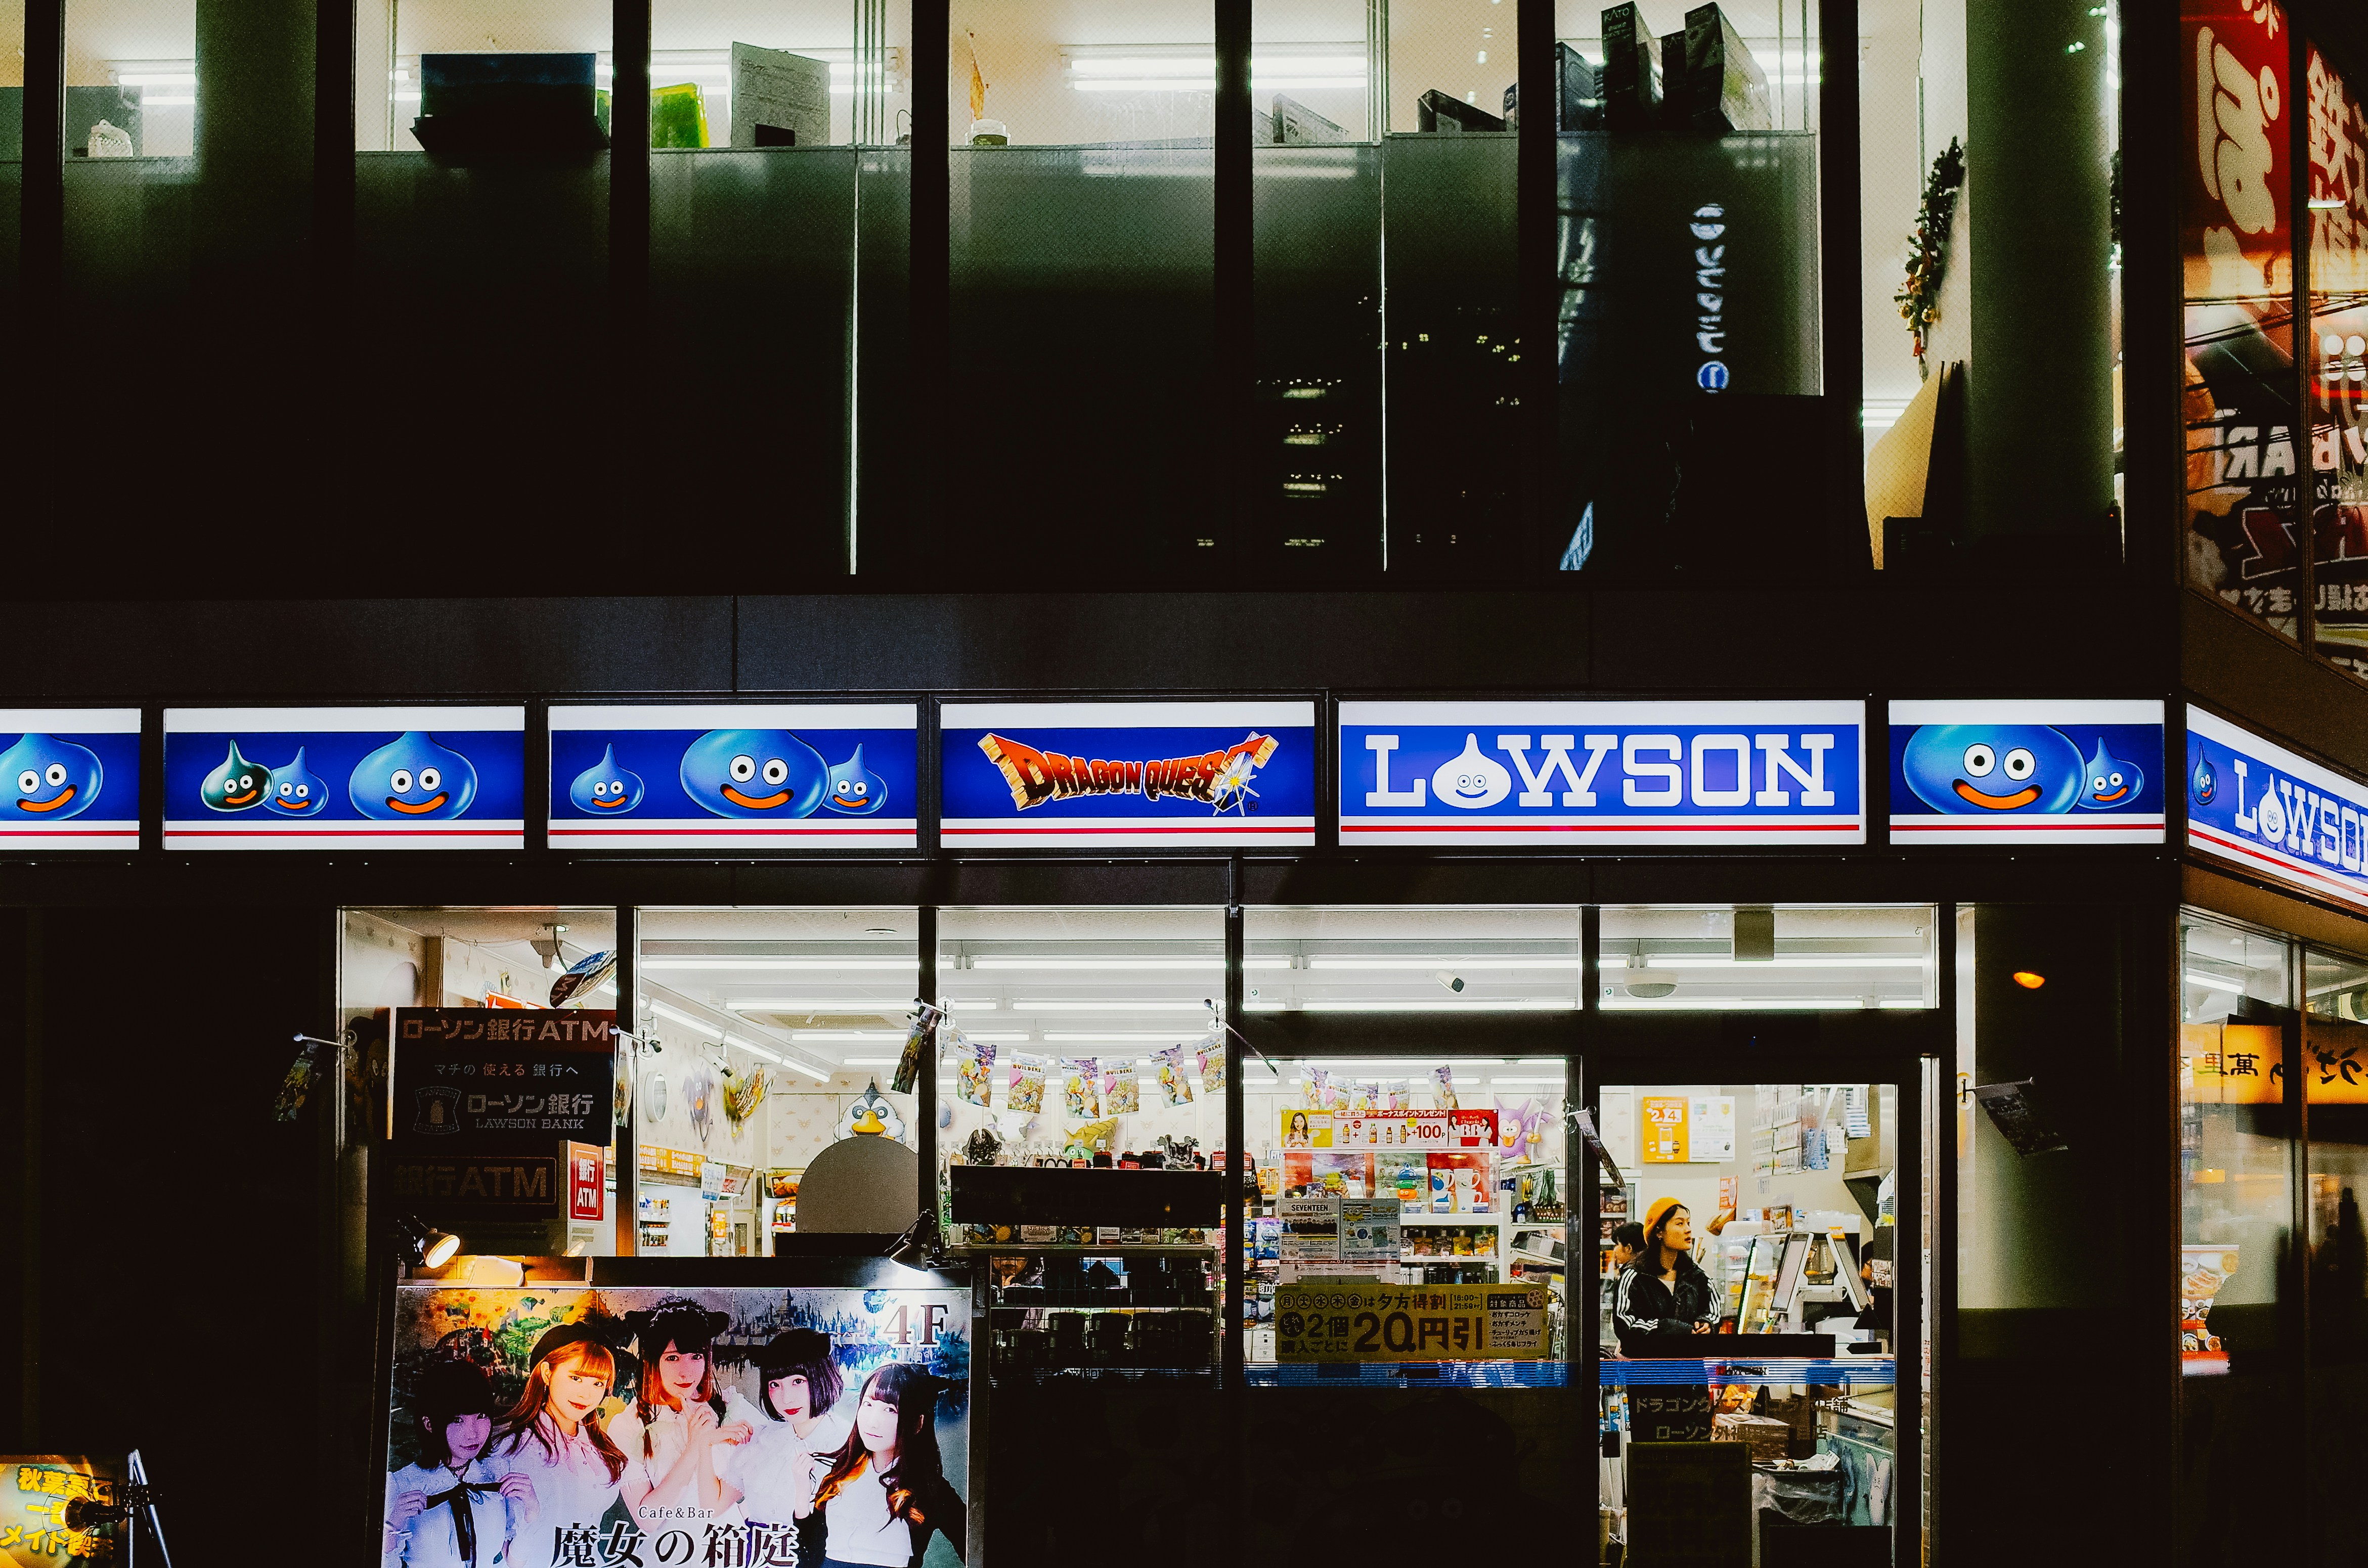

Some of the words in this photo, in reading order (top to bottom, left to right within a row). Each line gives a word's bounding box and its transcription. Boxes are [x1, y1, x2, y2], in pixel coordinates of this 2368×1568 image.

[978, 732, 1143, 811] DRAGON
[1145, 733, 1279, 810] QUEST
[403, 1017, 608, 1042] ローソン銀行ATM
[1197, 1044, 1221, 1056] BUILDERS
[434, 1063, 475, 1076] マチの
[483, 1063, 525, 1077] 使える
[533, 1063, 579, 1077] 銀行へ
[1013, 1064, 1041, 1072] BUILDERS
[467, 1093, 594, 1116] ローソン銀行
[475, 1118, 537, 1129] LAWSON
[541, 1118, 584, 1129] BANK
[578, 1159, 595, 1183] 銀行
[577, 1187, 597, 1209] ATM
[1291, 1204, 1329, 1212] SEVENTEEN
[1489, 1300, 1526, 1309] 対象商品
[883, 1305, 949, 1345] 4F
[638, 1506, 714, 1518] Cafe&Bar
[551, 1521, 800, 1568] 魔女の箱庭
